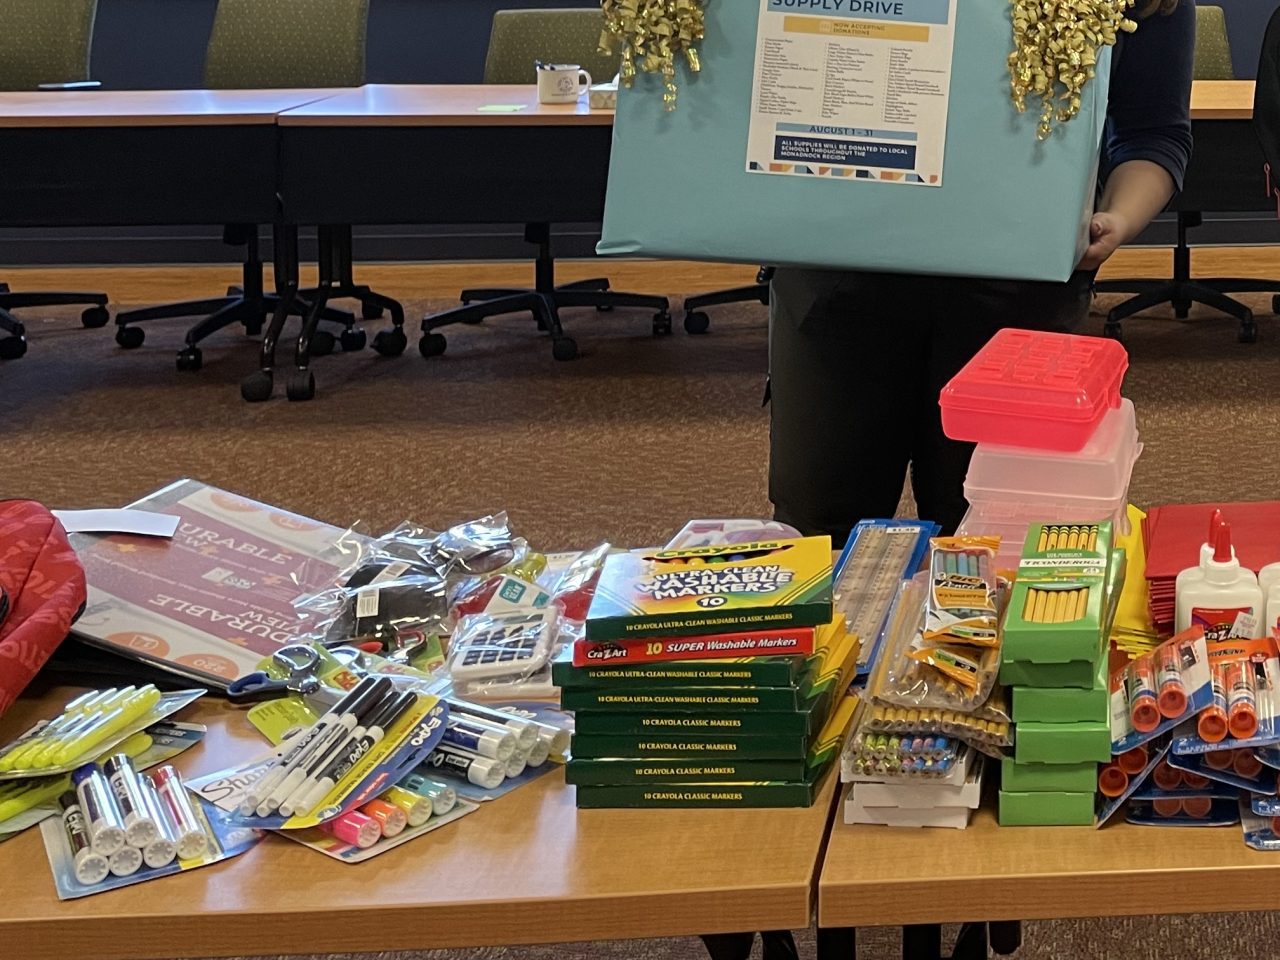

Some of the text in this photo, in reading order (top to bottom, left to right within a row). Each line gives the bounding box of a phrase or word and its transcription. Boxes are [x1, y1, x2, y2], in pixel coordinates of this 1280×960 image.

[849, 0, 904, 16] DRIVE
[809, 125, 848, 136] AUGUST
[864, 129, 873, 137] 31
[848, 145, 878, 153] DONATED
[178, 521, 293, 566] URABLE
[655, 542, 780, 558] Crayola
[655, 565, 779, 581] ULTRA-CLEAN
[635, 572, 793, 592] WASHABLE
[654, 582, 777, 600] MARKERS
[700, 597, 726, 607] 10
[145, 593, 296, 645] DURABLE
[633, 623, 663, 631] CRAYOLA
[663, 620, 705, 629] ULTRA-CLEAN
[706, 617, 738, 626] WASHABLE
[739, 615, 764, 623] CLASSIC
[764, 613, 793, 621] MARKERS
[646, 642, 663, 656] 10
[666, 642, 705, 653] SUPER
[706, 638, 756, 651] Washable
[757, 637, 798, 648] Markers
[705, 743, 737, 751] MARKERS
